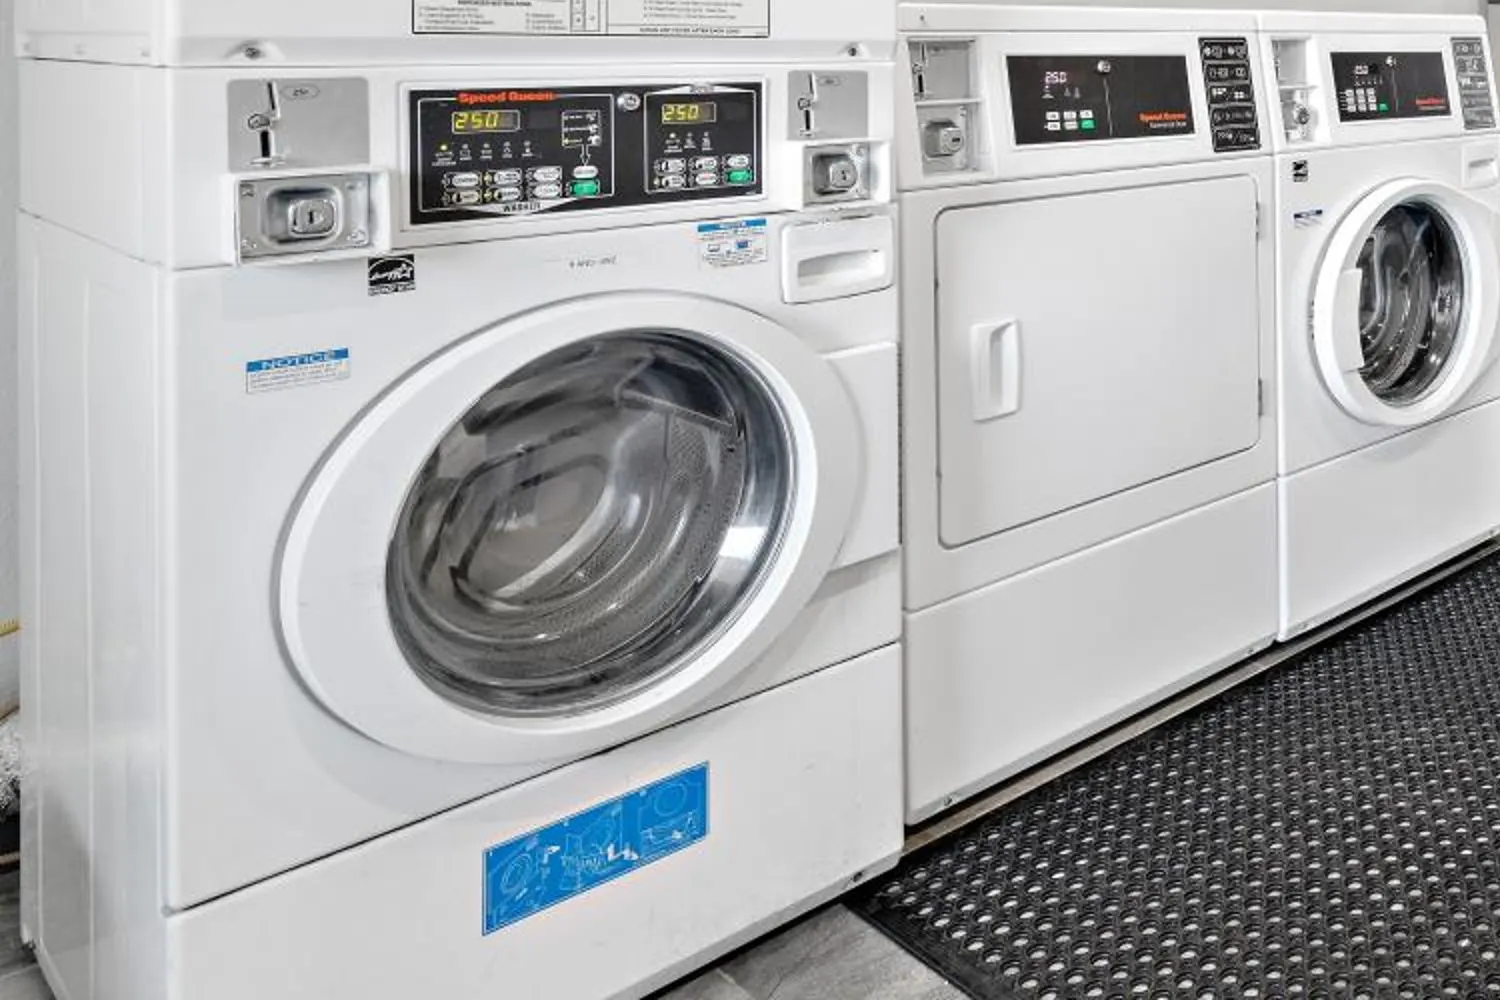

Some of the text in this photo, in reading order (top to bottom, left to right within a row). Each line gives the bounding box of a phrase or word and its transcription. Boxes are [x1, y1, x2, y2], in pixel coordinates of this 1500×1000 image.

[459, 90, 553, 104] Speed Queen
[455, 111, 499, 129] 250
[663, 104, 699, 121] 250
